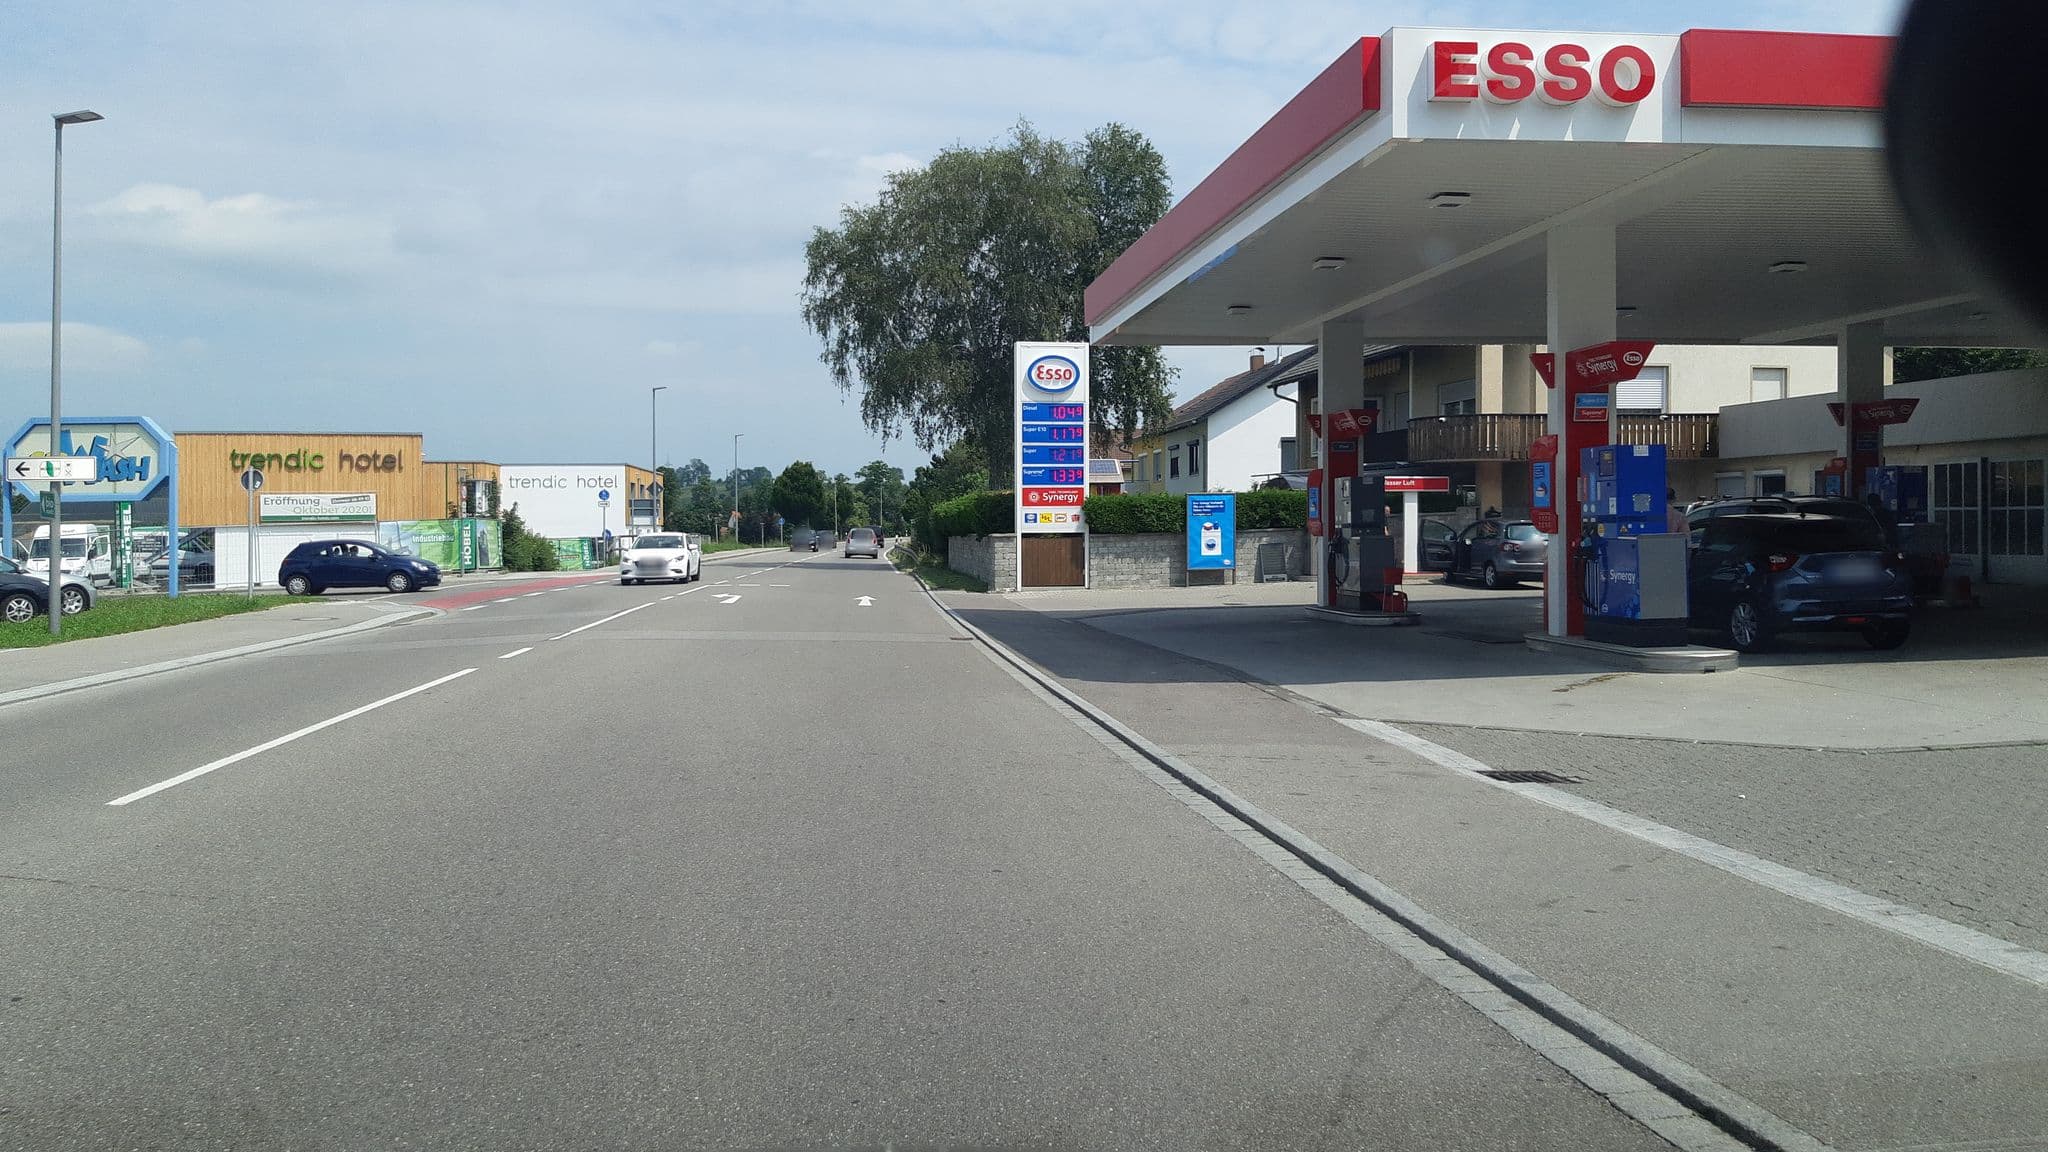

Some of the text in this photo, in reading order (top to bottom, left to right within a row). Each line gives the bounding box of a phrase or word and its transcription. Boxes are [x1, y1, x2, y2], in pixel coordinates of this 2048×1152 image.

[1432, 41, 1656, 103] ESSO
[1036, 365, 1073, 380] Esso
[1546, 361, 1552, 373] 1
[1586, 359, 1618, 375] Synergy
[230, 448, 403, 472] trendic hotel
[509, 475, 619, 489] trendic hotel
[263, 496, 320, 506] Eröffnung
[1042, 493, 1079, 503] Synergy
[293, 506, 339, 514] Oktober
[1609, 569, 1636, 584] Synergy
